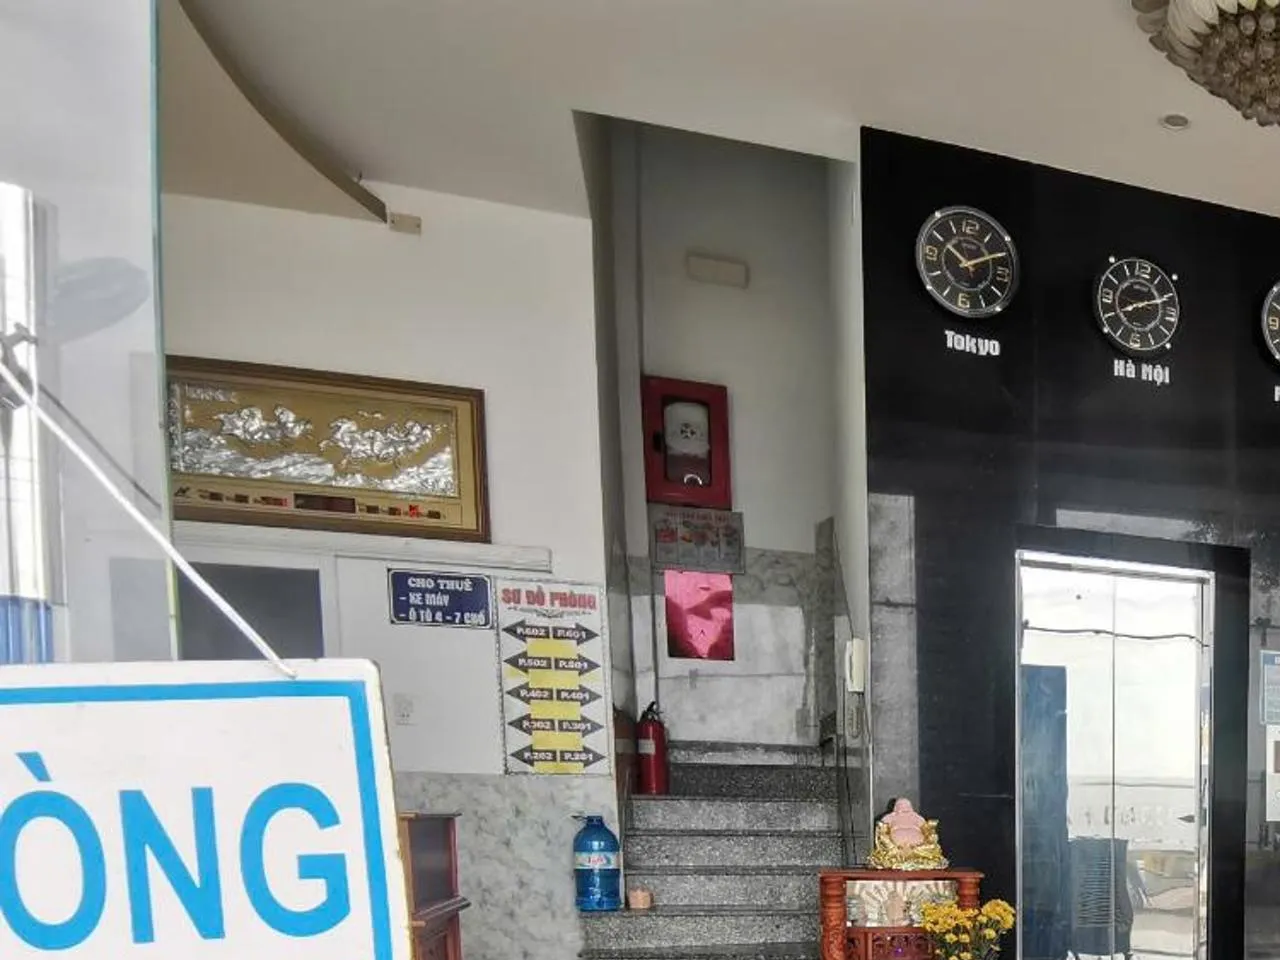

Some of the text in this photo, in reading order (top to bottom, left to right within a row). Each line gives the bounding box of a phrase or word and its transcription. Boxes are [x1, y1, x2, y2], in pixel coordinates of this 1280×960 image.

[962, 219, 980, 235] 12
[944, 329, 1001, 356] Tokyo
[1113, 358, 1171, 387] Hà Nội
[407, 576, 474, 592] CHO THUÊ
[454, 611, 462, 624] 7
[0, 751, 351, 951] ÒNG
